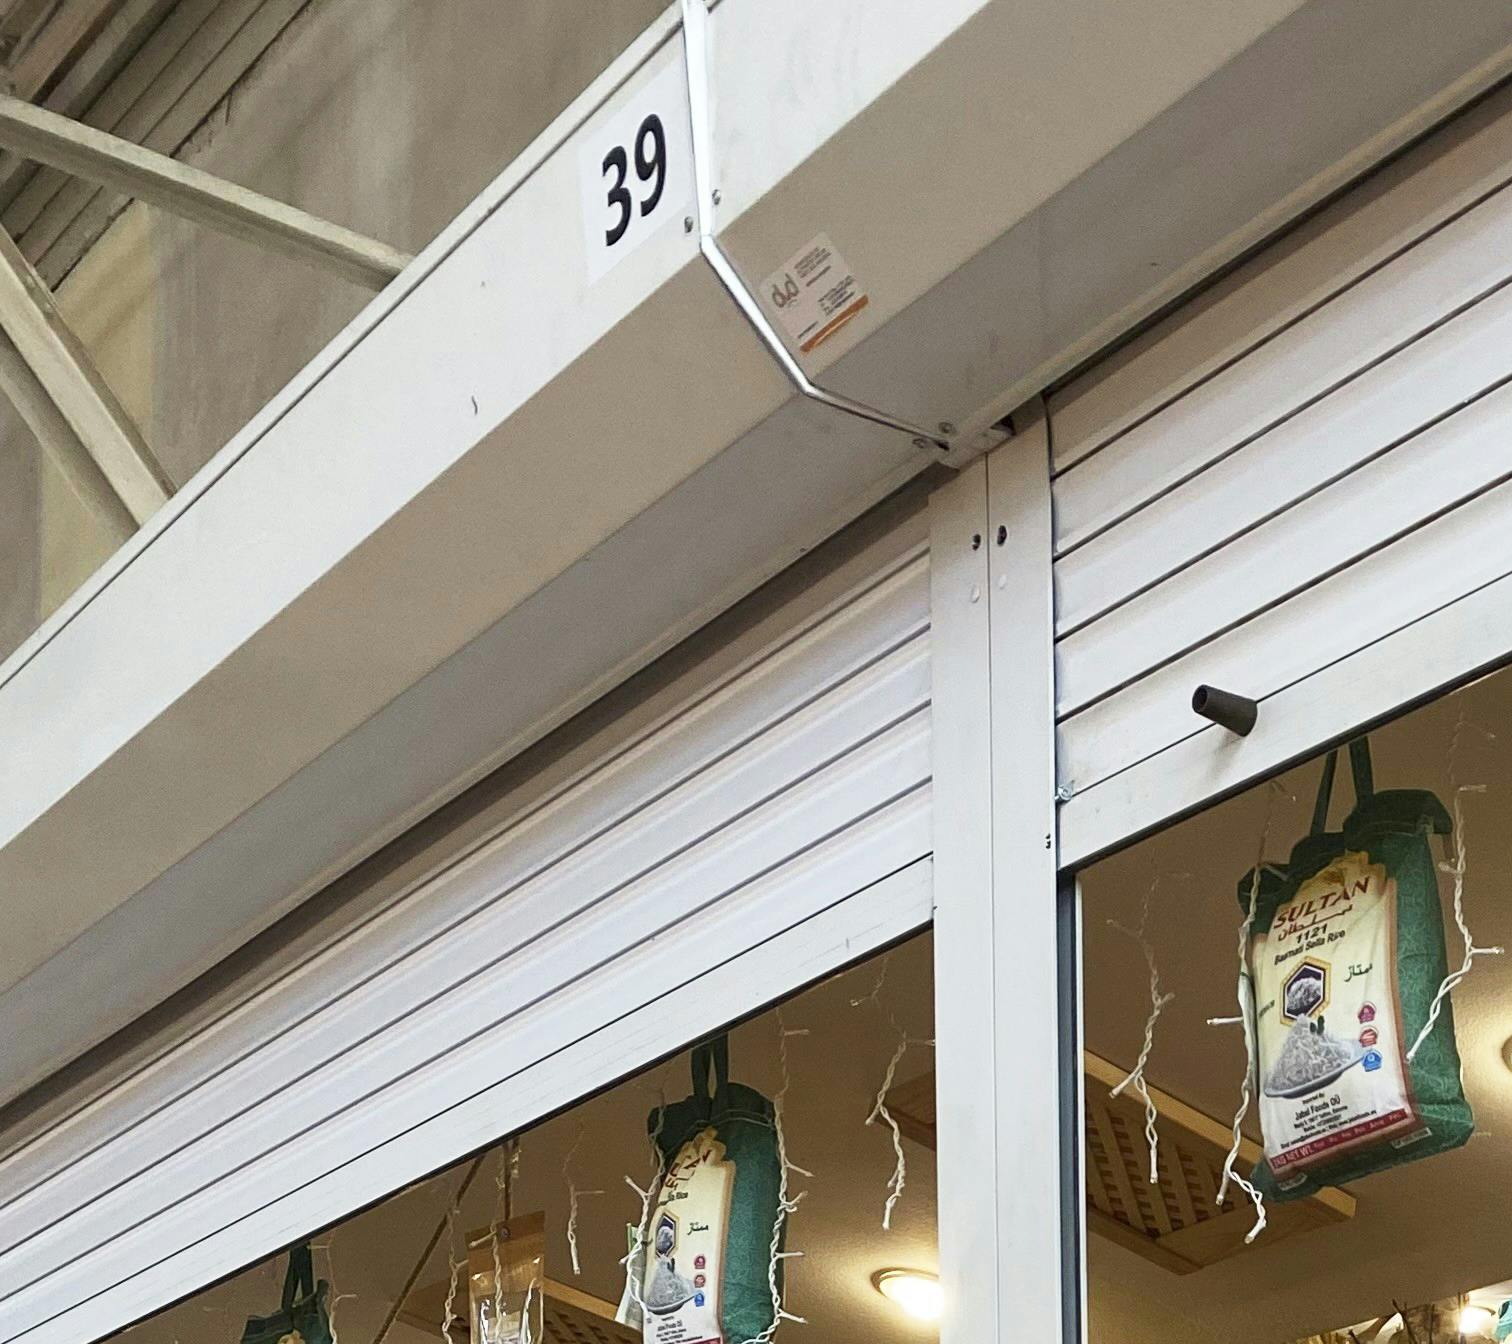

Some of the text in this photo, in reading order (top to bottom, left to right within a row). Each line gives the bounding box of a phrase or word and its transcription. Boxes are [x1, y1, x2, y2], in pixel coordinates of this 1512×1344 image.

[602, 113, 666, 247] 39
[1273, 876, 1370, 929] SULTAN
[1296, 923, 1328, 943] 1121
